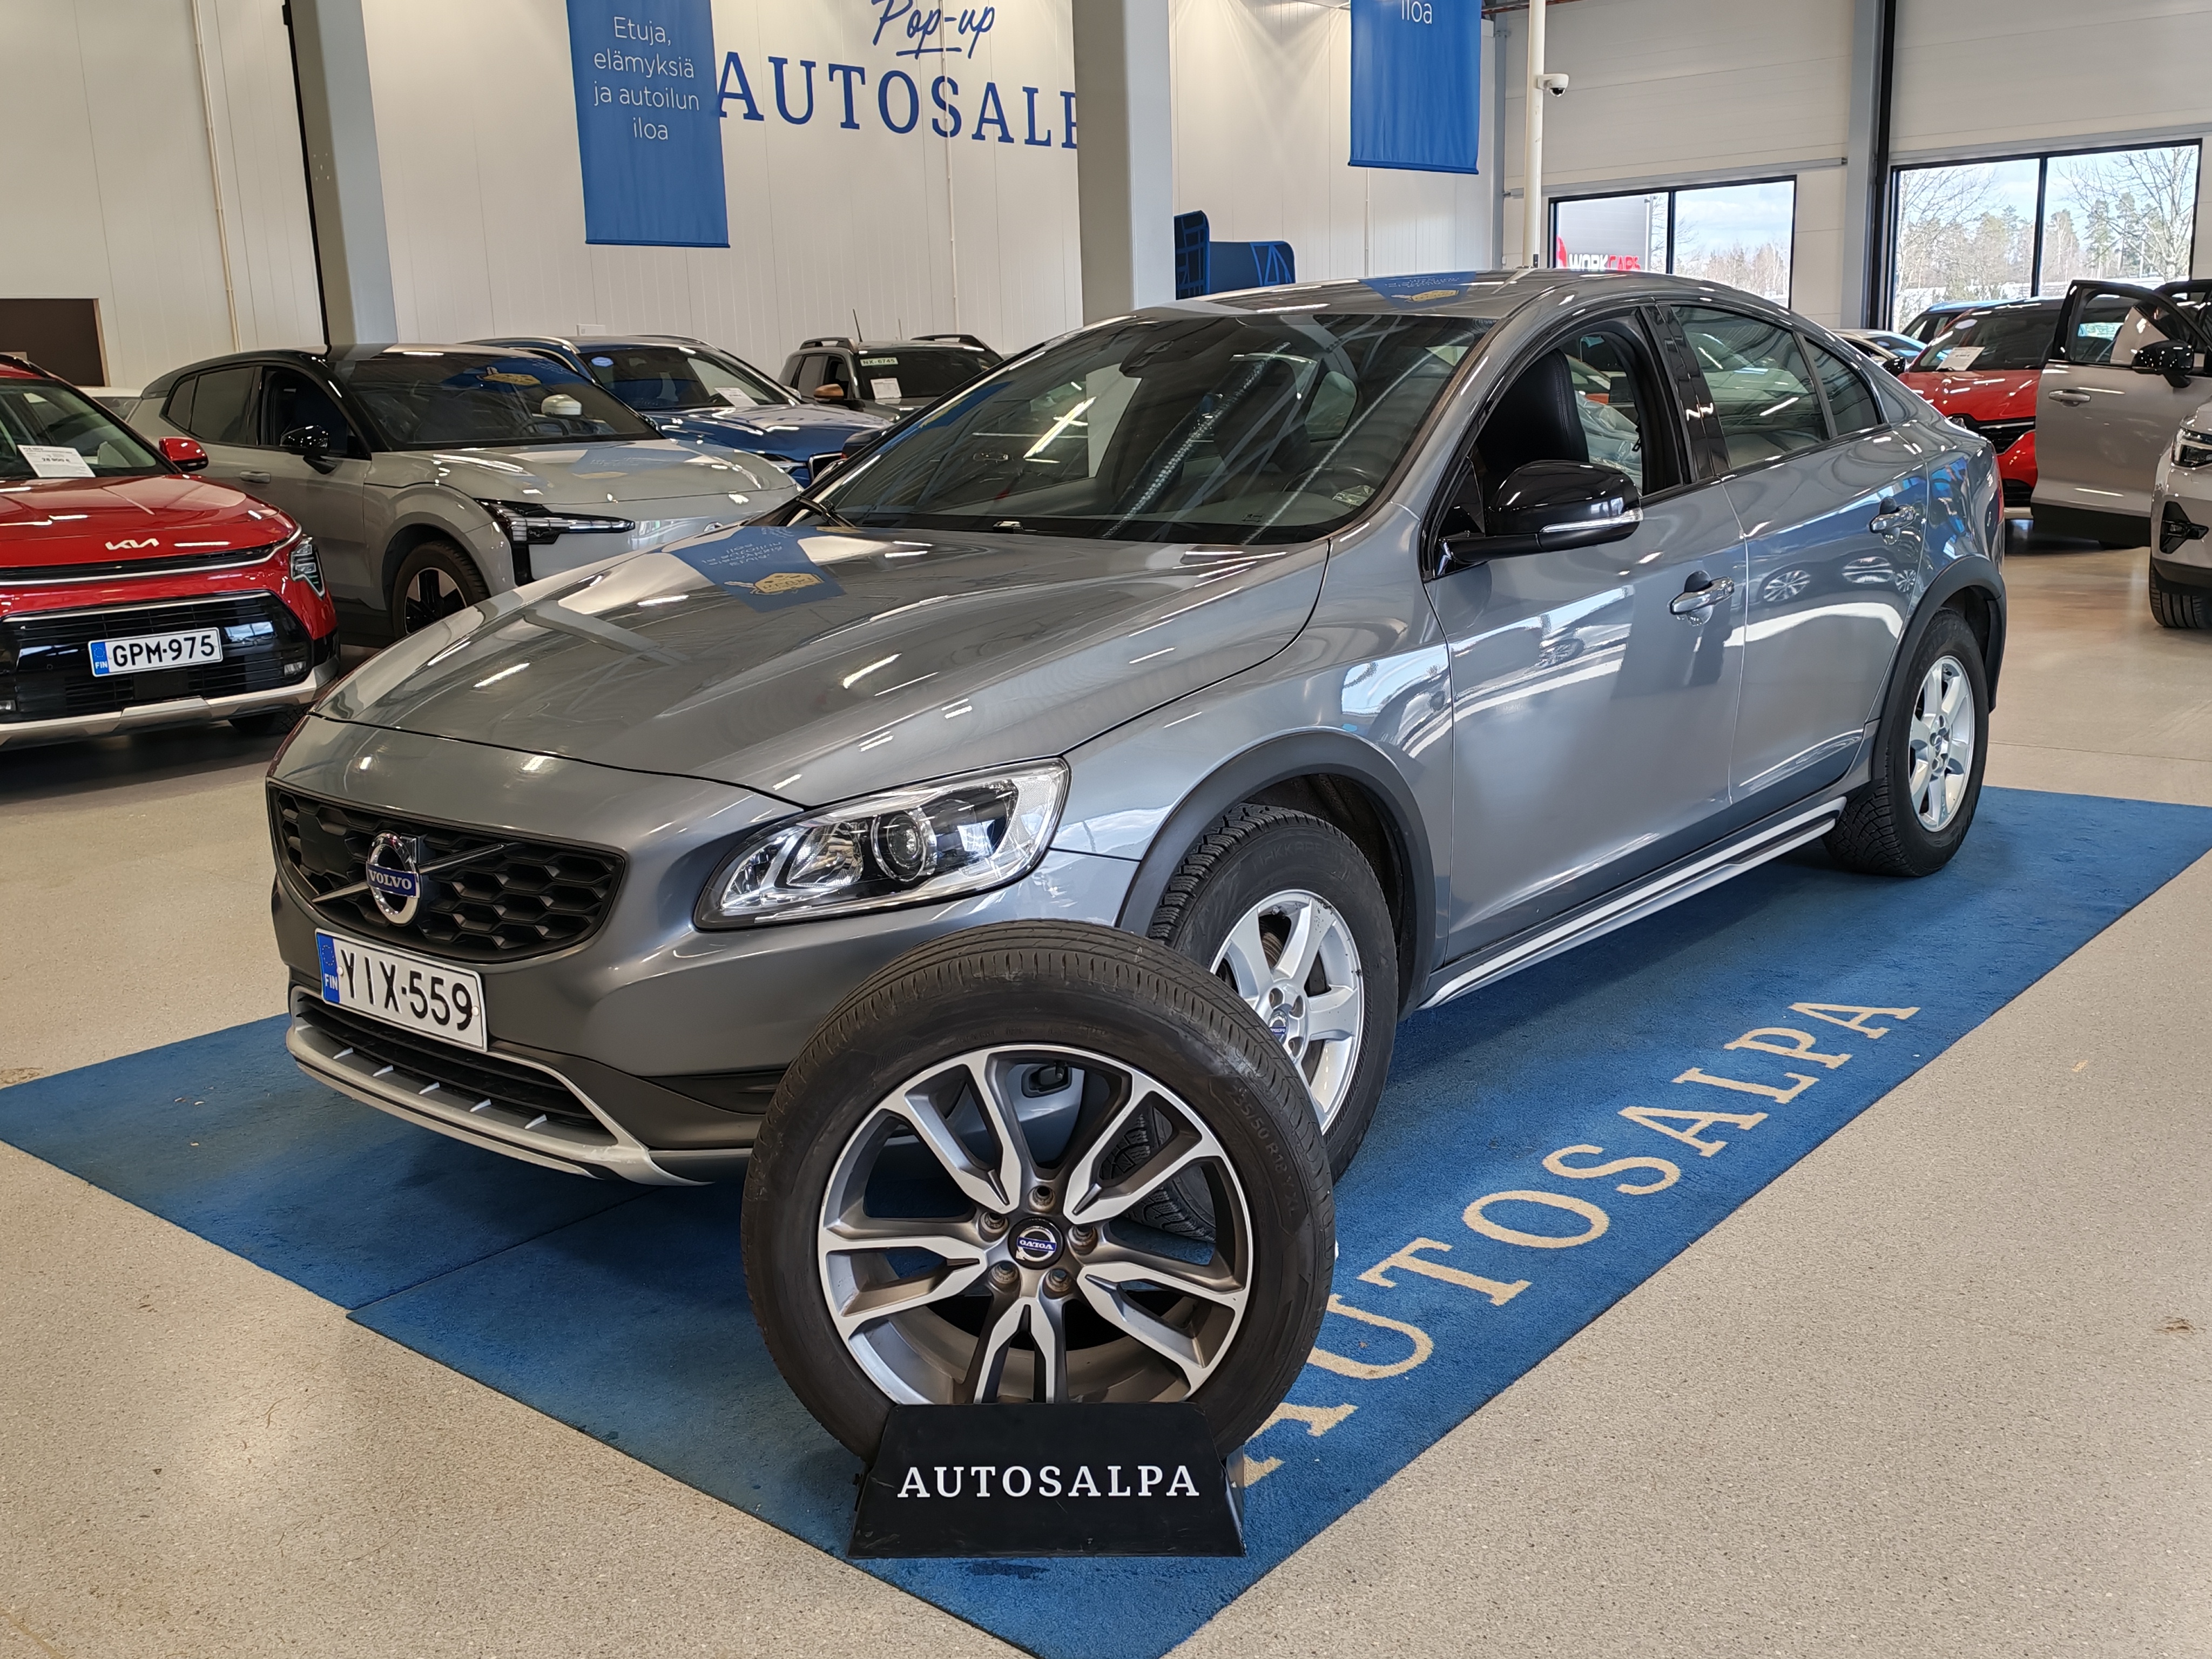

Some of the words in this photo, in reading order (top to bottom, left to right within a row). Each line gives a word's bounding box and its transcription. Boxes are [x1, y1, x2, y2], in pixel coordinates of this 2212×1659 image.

[613, 16, 671, 46] Etuja,
[871, 0, 995, 59] Pop-up
[594, 48, 694, 78] elämyksiä
[594, 81, 612, 106] ja
[619, 87, 700, 111] autoilun
[633, 117, 668, 140] iloa
[105, 538, 159, 550] KIA
[95, 660, 108, 669] FIN
[112, 635, 215, 667] GPM-975
[368, 869, 412, 890] VOLVO
[324, 973, 338, 990] FIN
[341, 949, 473, 1031] YIX-559
[1019, 1239, 1054, 1250] VOLVO
[897, 1465, 1200, 1498] AUTOSALPA
